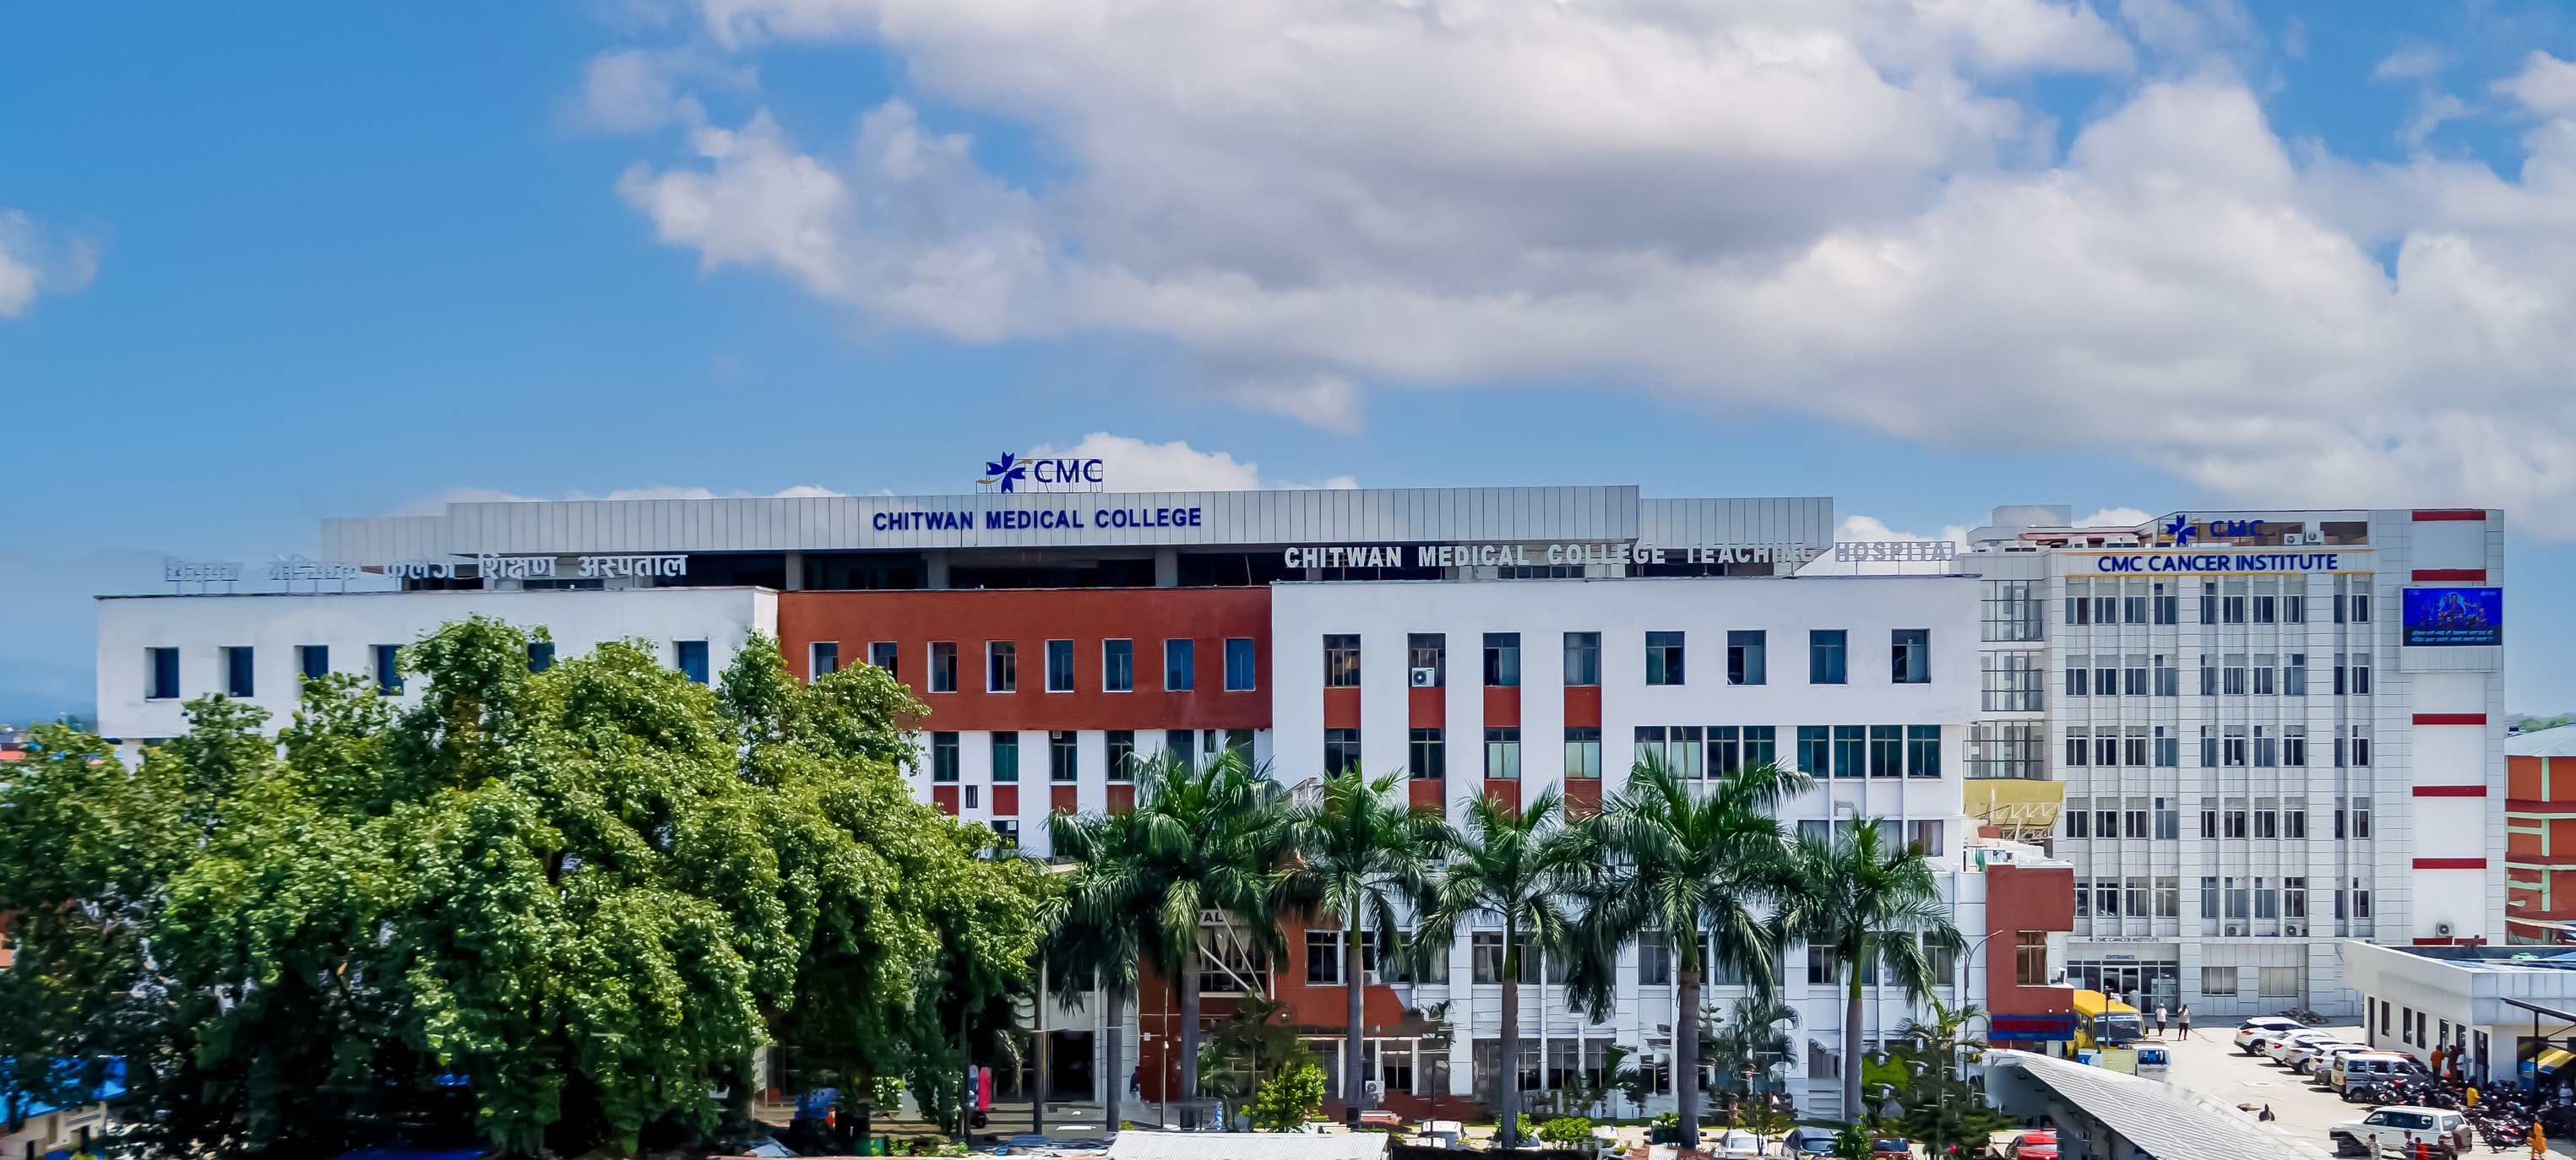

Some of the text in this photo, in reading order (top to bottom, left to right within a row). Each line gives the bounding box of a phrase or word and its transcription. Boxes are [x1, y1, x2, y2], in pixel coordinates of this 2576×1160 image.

[1034, 459, 1103, 484] CMC
[873, 507, 1201, 531] CHITWAN MEDICAL COLLEGE
[2209, 519, 2264, 538] CMC
[478, 551, 557, 580] शिक्षण
[577, 555, 688, 578] अस्पताल
[1285, 540, 1956, 568] CHITWAN MEDICAL COLLEGE TEACHING HOSPITAL
[2098, 554, 2338, 572] CMC CANCER INSTITUTE
